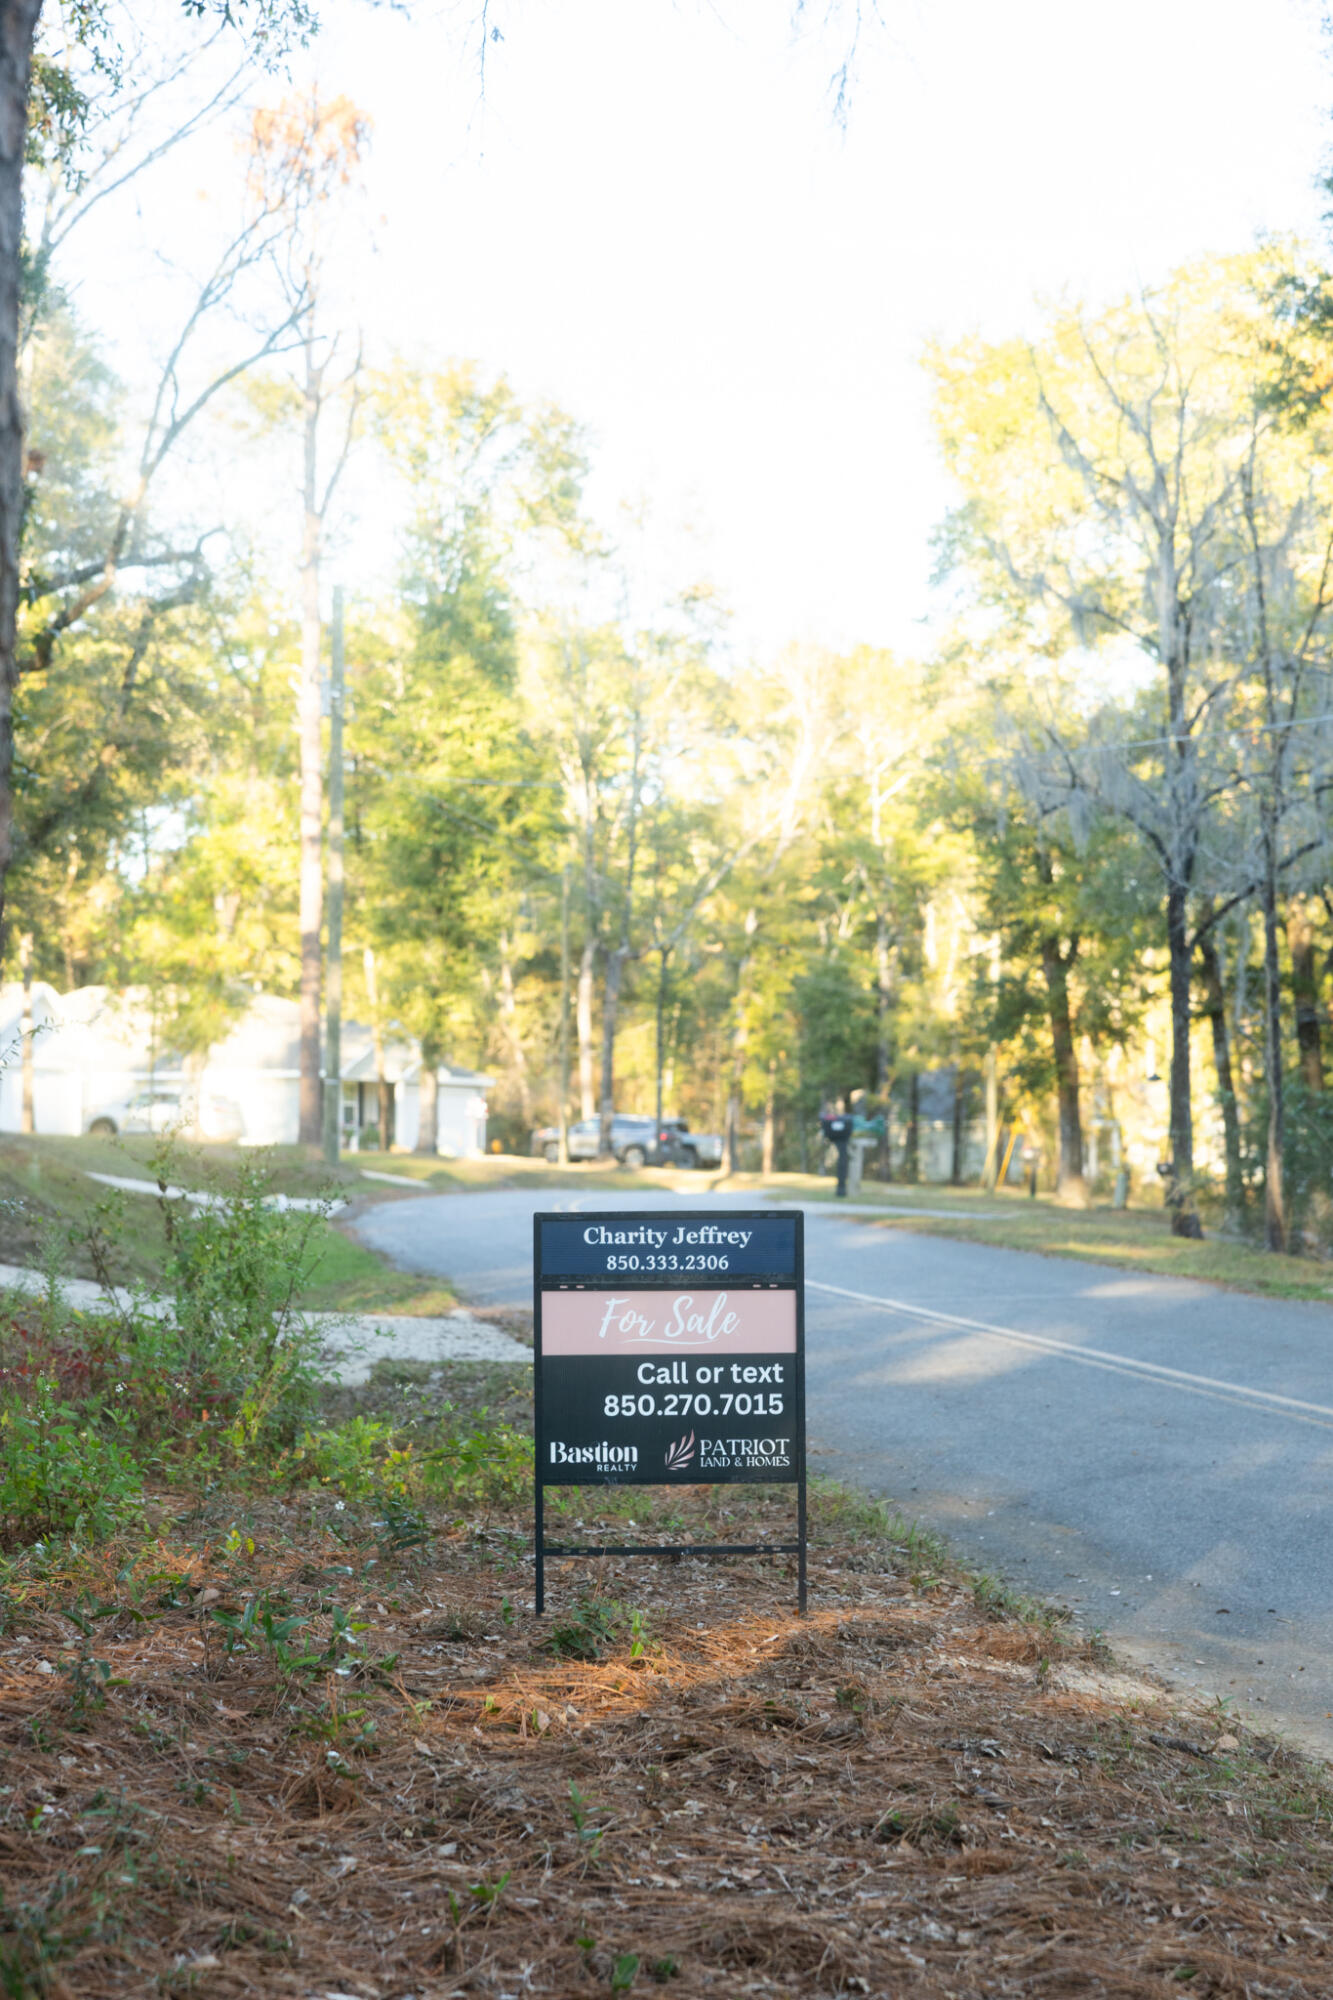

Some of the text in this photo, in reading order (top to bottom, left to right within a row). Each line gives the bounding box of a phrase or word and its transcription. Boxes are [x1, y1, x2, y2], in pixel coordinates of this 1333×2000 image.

[583, 1226, 753, 1248] Charity Jeffrey
[606, 1255, 729, 1271] 850.333.2306
[598, 1292, 740, 1340] For Sale
[637, 1361, 784, 1385] Call or text
[604, 1393, 784, 1417] 850.270.7015
[550, 1441, 639, 1464] Bastion
[700, 1438, 790, 1456] PATRIOT
[597, 1464, 638, 1472] REALTY
[700, 1455, 790, 1467] LAND & HOMES
